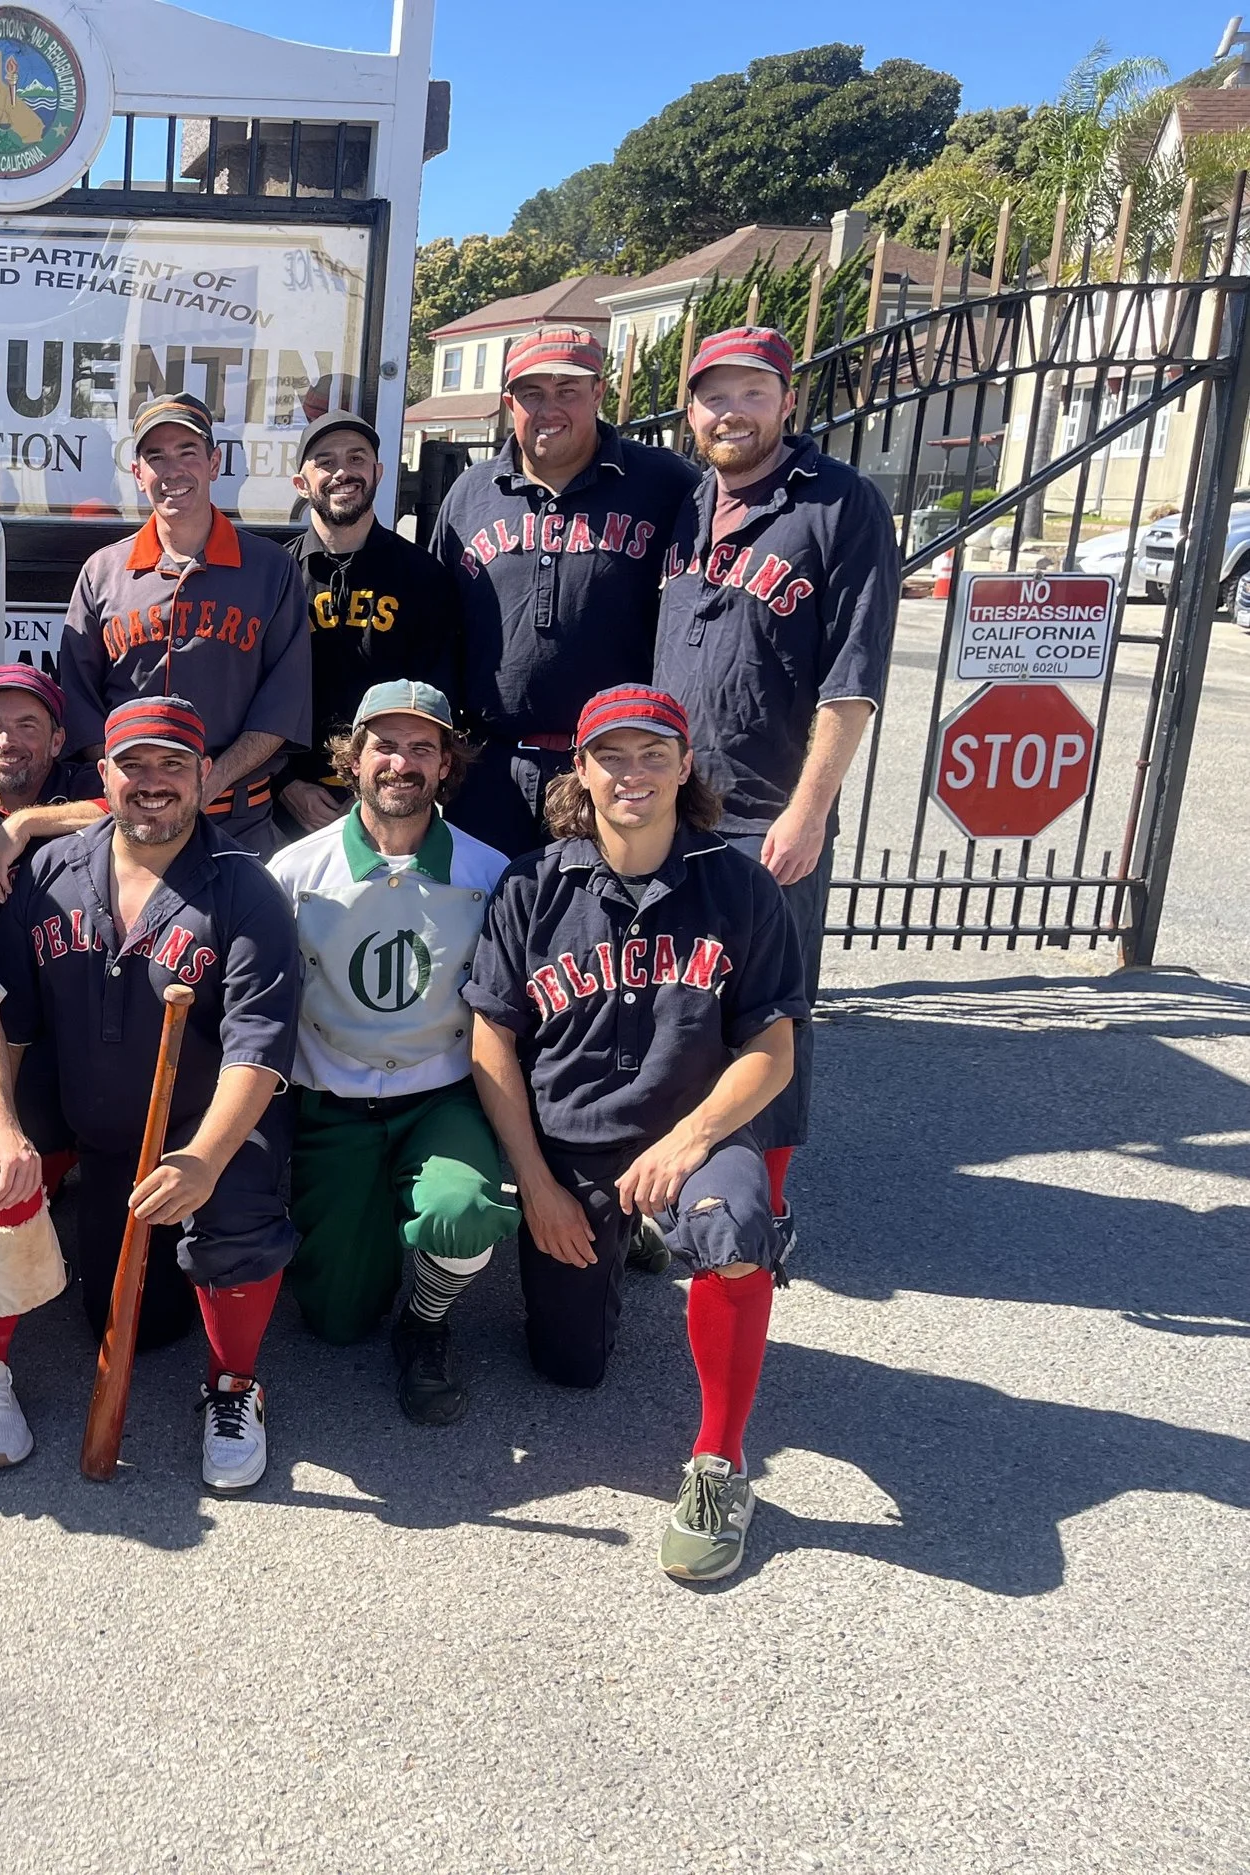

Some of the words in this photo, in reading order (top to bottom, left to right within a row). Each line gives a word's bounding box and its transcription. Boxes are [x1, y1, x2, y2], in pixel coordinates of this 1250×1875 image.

[30, 26, 49, 48] AND
[44, 41, 77, 112] REHABILITATION
[0, 146, 47, 172] CALIFORNIA
[193, 271, 237, 292] OF
[35, 270, 274, 328] REHABILITATION
[114, 436, 302, 477] CTER
[459, 512, 655, 579] PELICANS
[1020, 581, 1051, 604] NO
[972, 606, 1105, 621] TRESPASSING
[972, 626, 1096, 641] CALIFORNIA
[964, 646, 1026, 660] PENAL
[1036, 645, 1101, 659] CODE
[987, 663, 1028, 673] SECTION
[1032, 662, 1068, 674] 602(L)
[945, 734, 1086, 789] STOP
